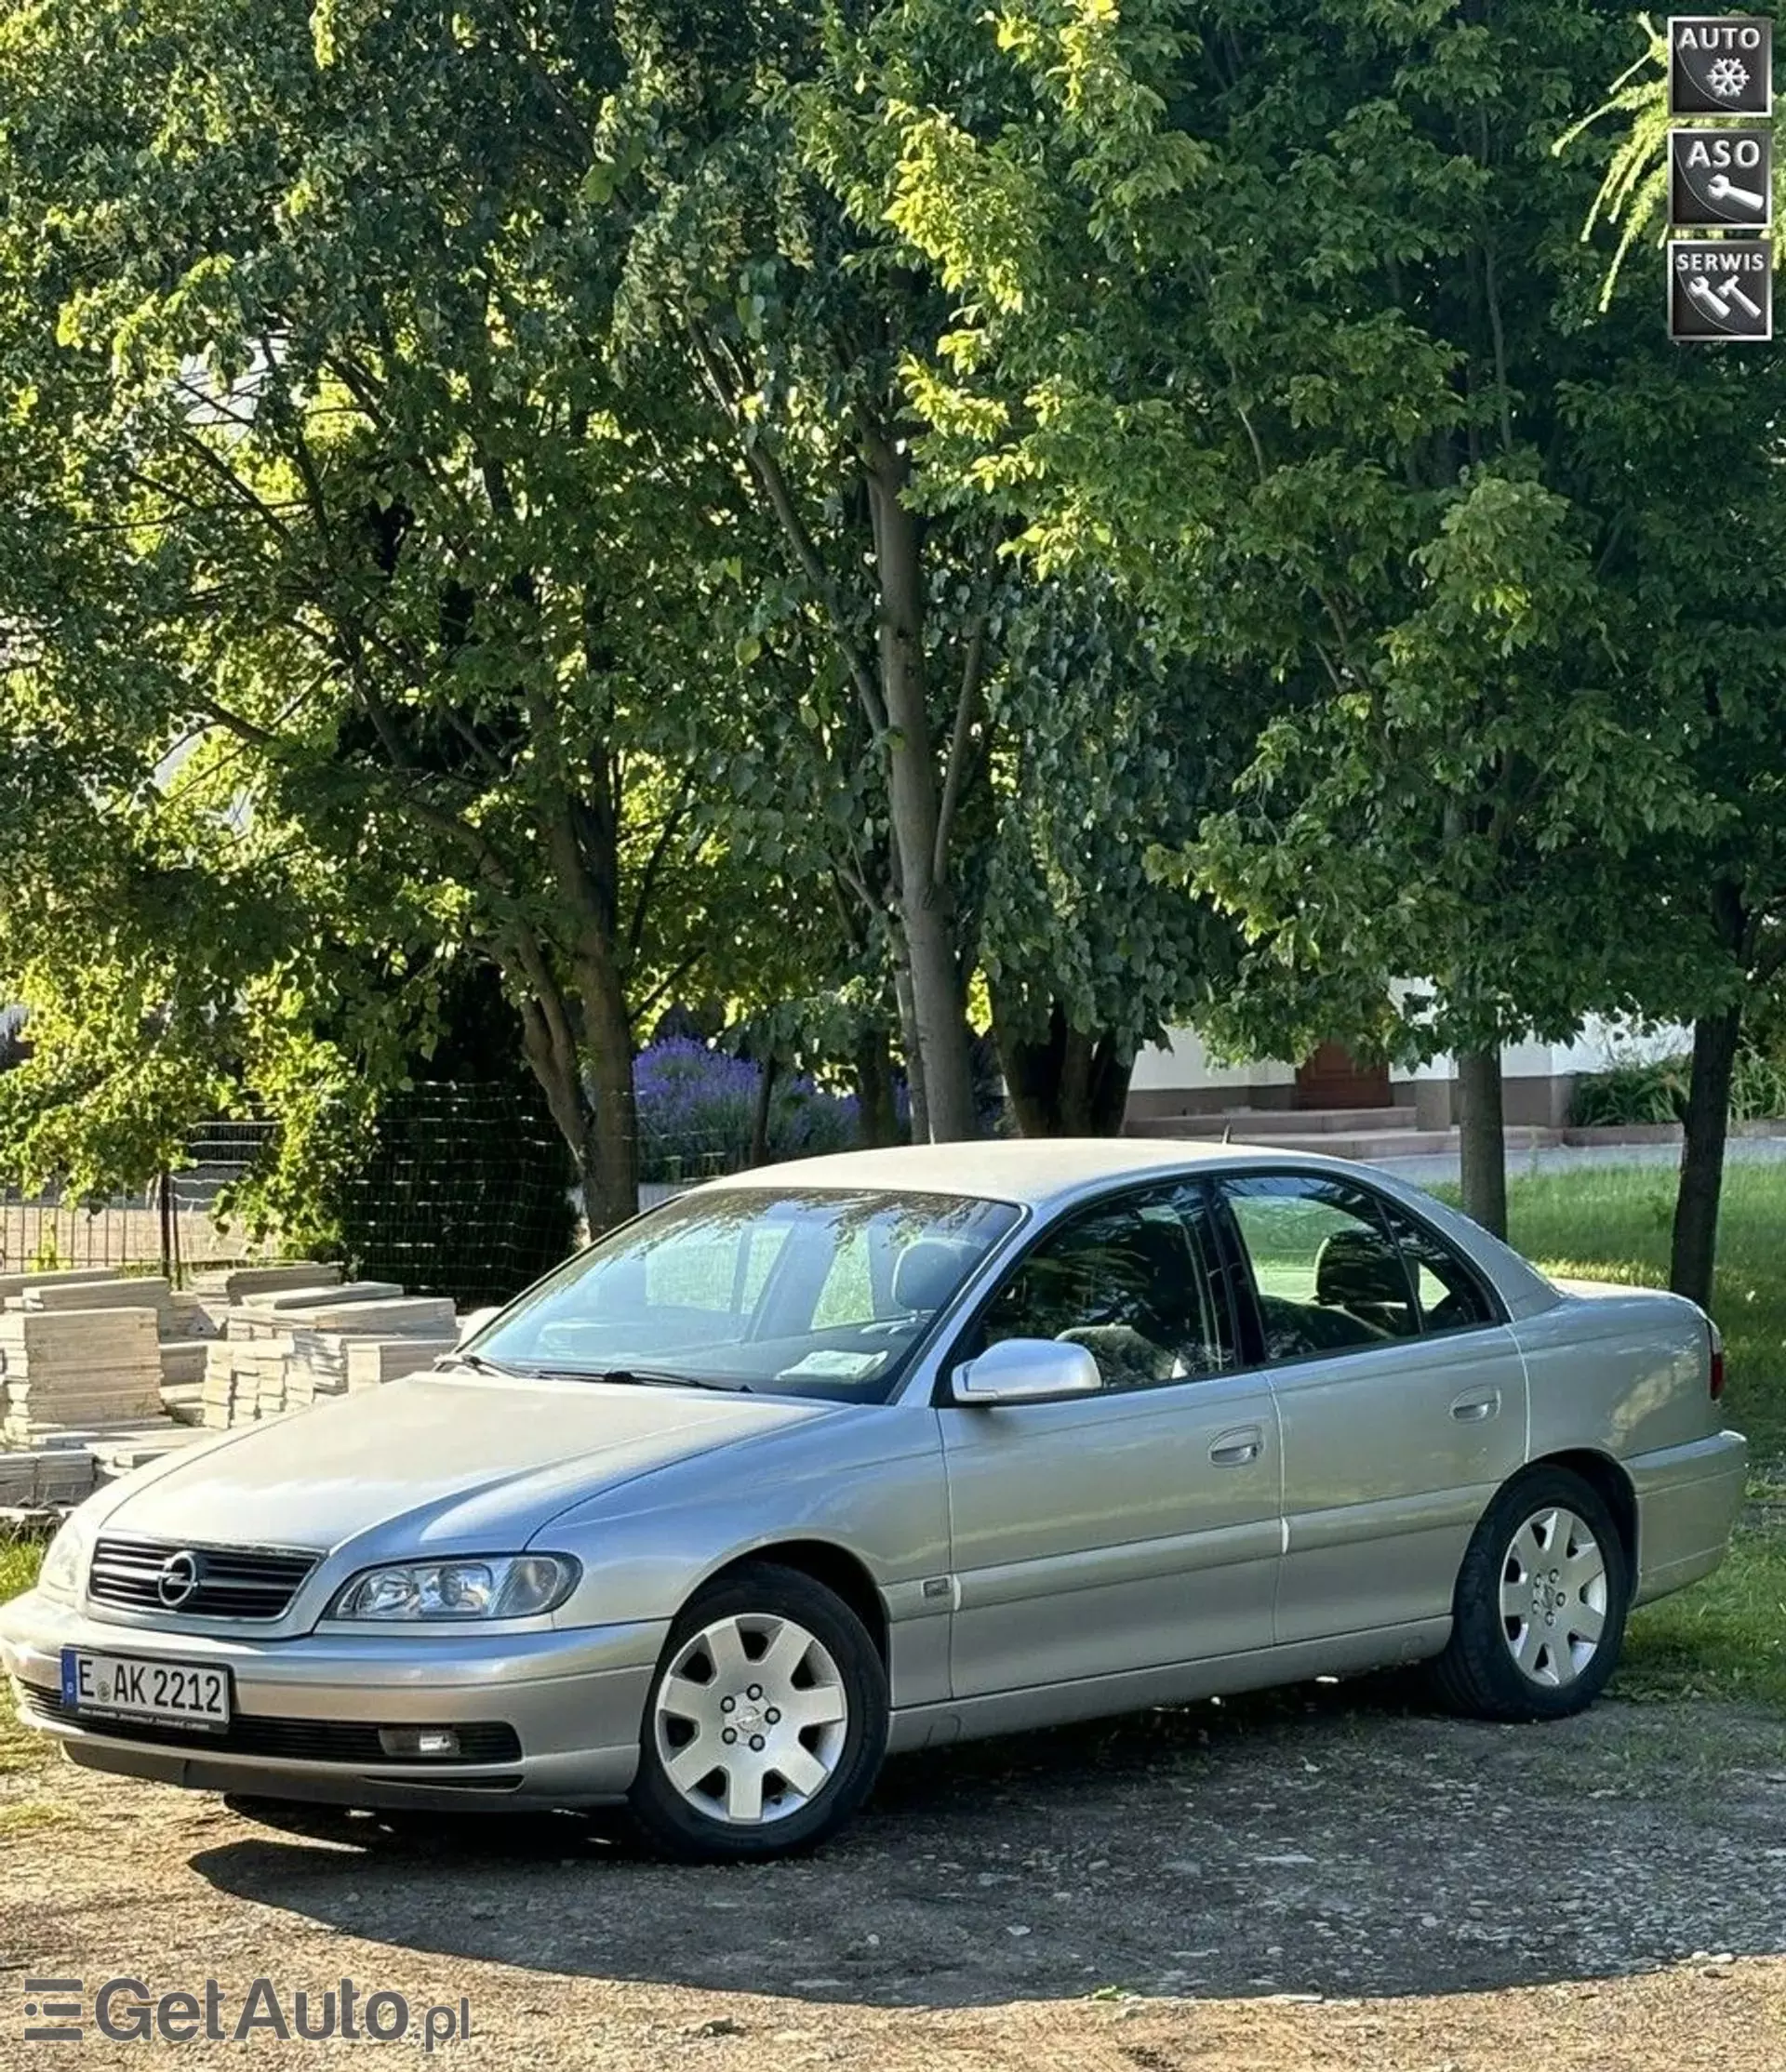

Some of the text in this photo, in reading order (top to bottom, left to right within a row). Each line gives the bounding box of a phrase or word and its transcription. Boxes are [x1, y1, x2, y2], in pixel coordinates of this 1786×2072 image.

[78, 1659, 222, 1713] E AK 2212
